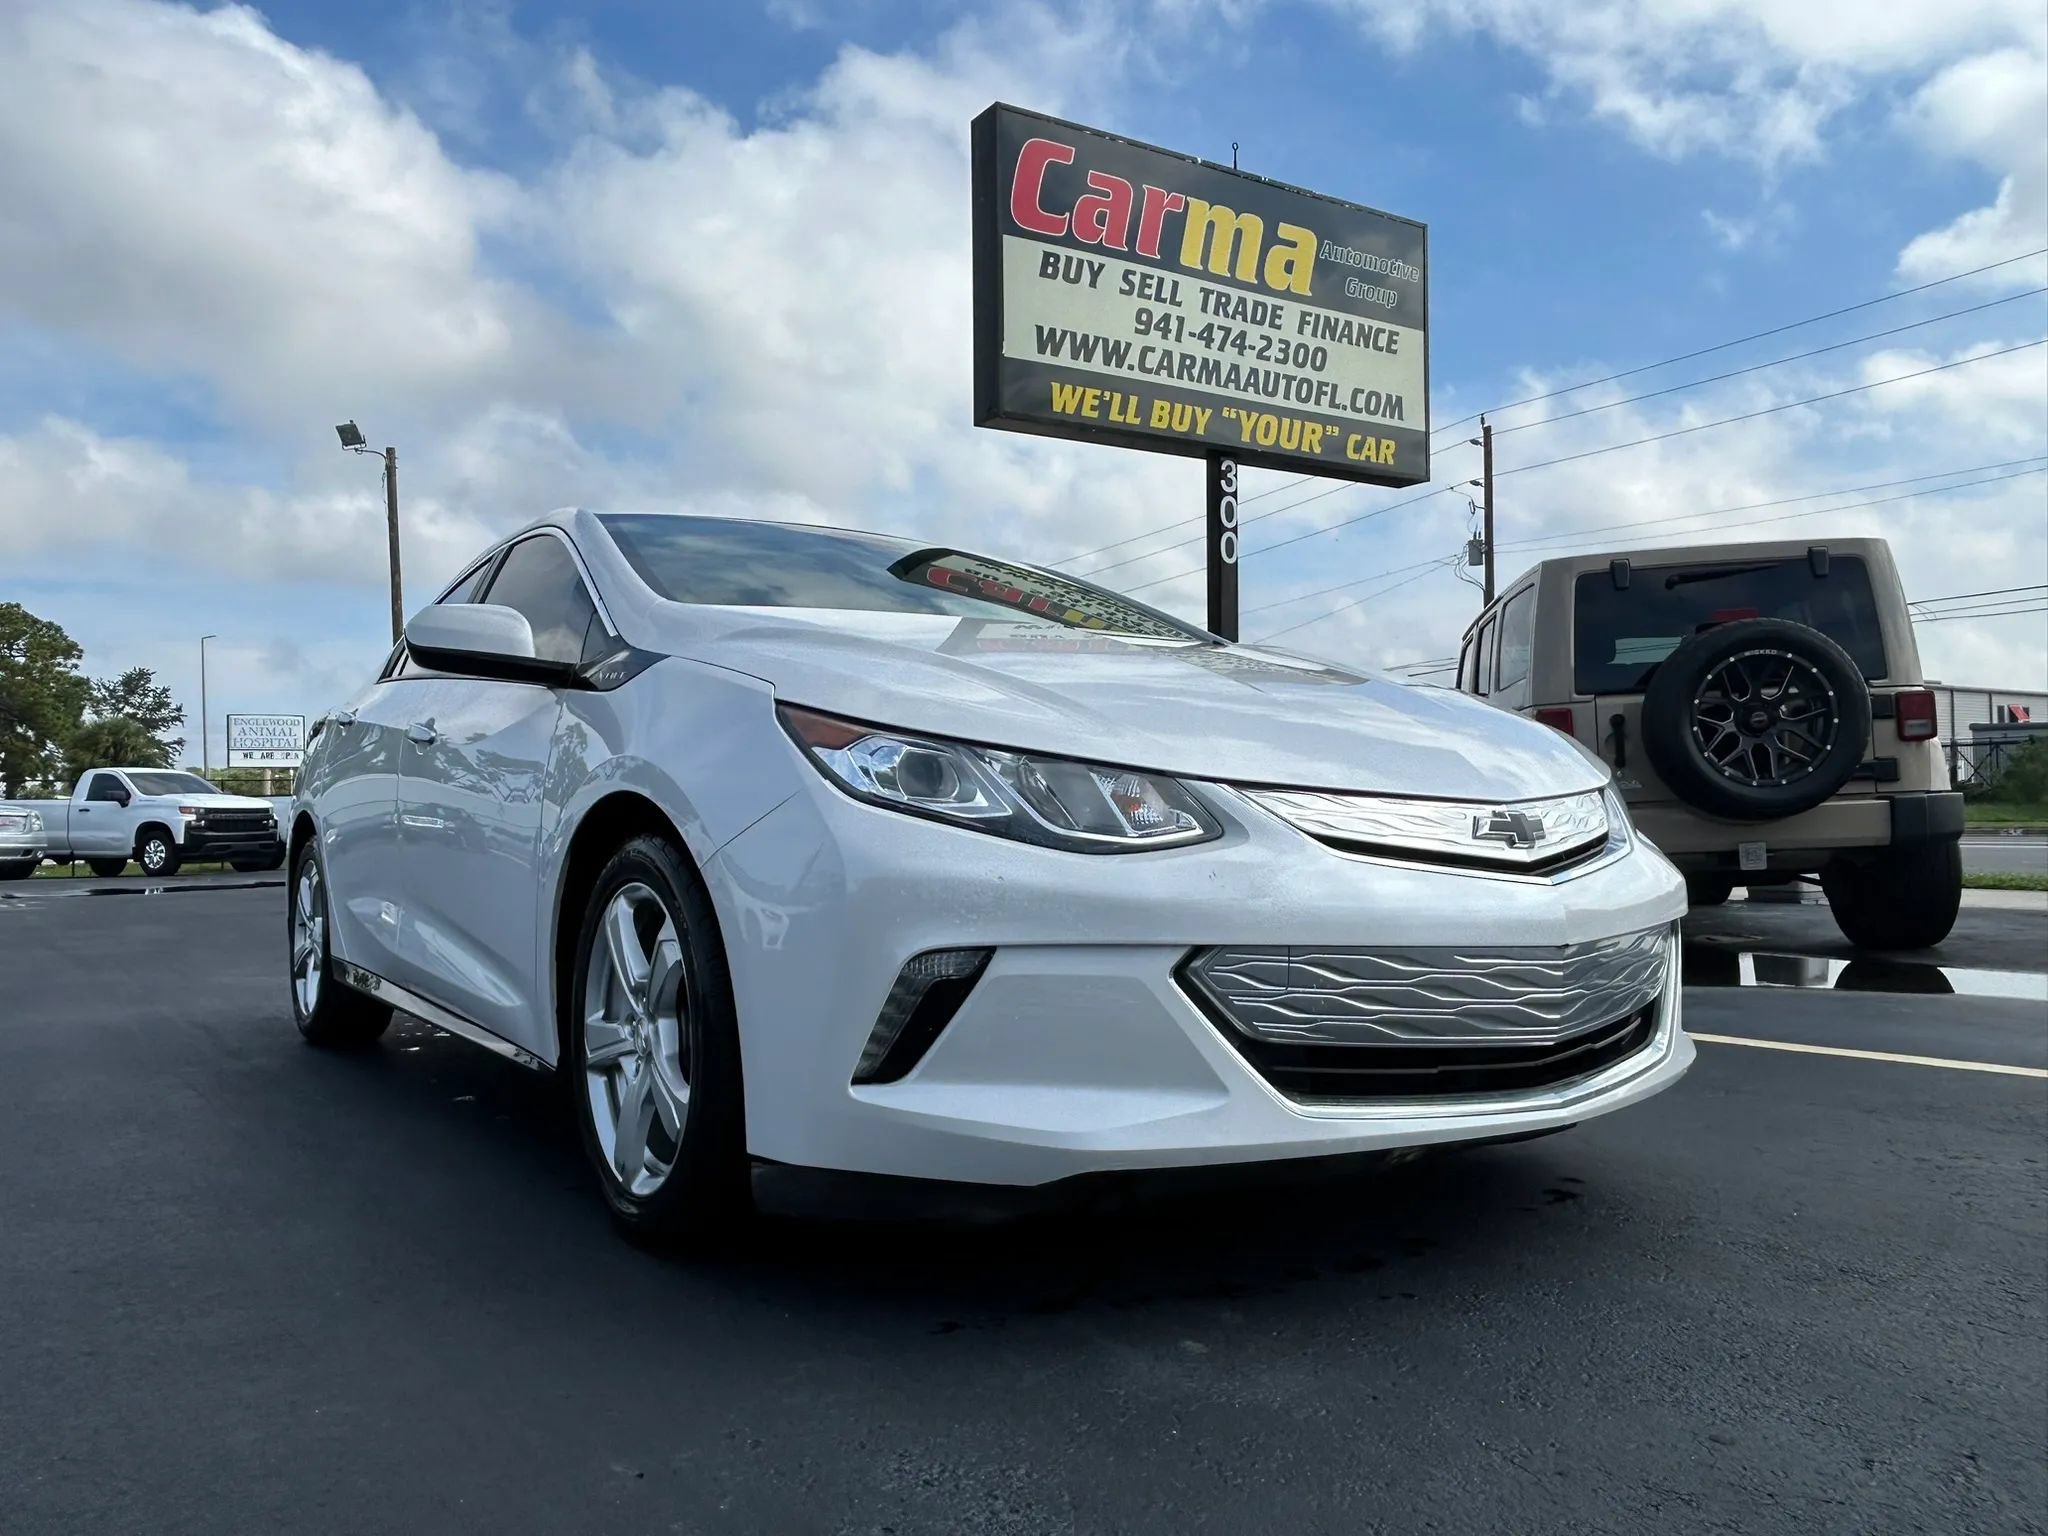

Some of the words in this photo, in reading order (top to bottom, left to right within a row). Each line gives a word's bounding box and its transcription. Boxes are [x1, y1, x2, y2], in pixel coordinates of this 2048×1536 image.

[1010, 137, 1318, 297] Carma
[1320, 240, 1420, 282] Automotive
[1039, 250, 1106, 290] BUY
[1119, 268, 1182, 308] SELL
[1199, 287, 1284, 331] TRADE
[1299, 310, 1400, 355] FINANCE
[1345, 277, 1397, 309] Group
[1135, 308, 1328, 372] 941-474-2300
[1035, 325, 1404, 421] WWW.CARMAAUTOFL.COM
[1051, 382, 1142, 426] WE'LL
[1149, 399, 1212, 435] BUY
[1346, 433, 1396, 465] CAR
[1220, 459, 1238, 565] 300
[233, 718, 300, 726] ENGLEWOOD
[233, 737, 302, 748] HOSPITAL
[238, 727, 297, 737] ANIMAL
[242, 752, 254, 760] WE
